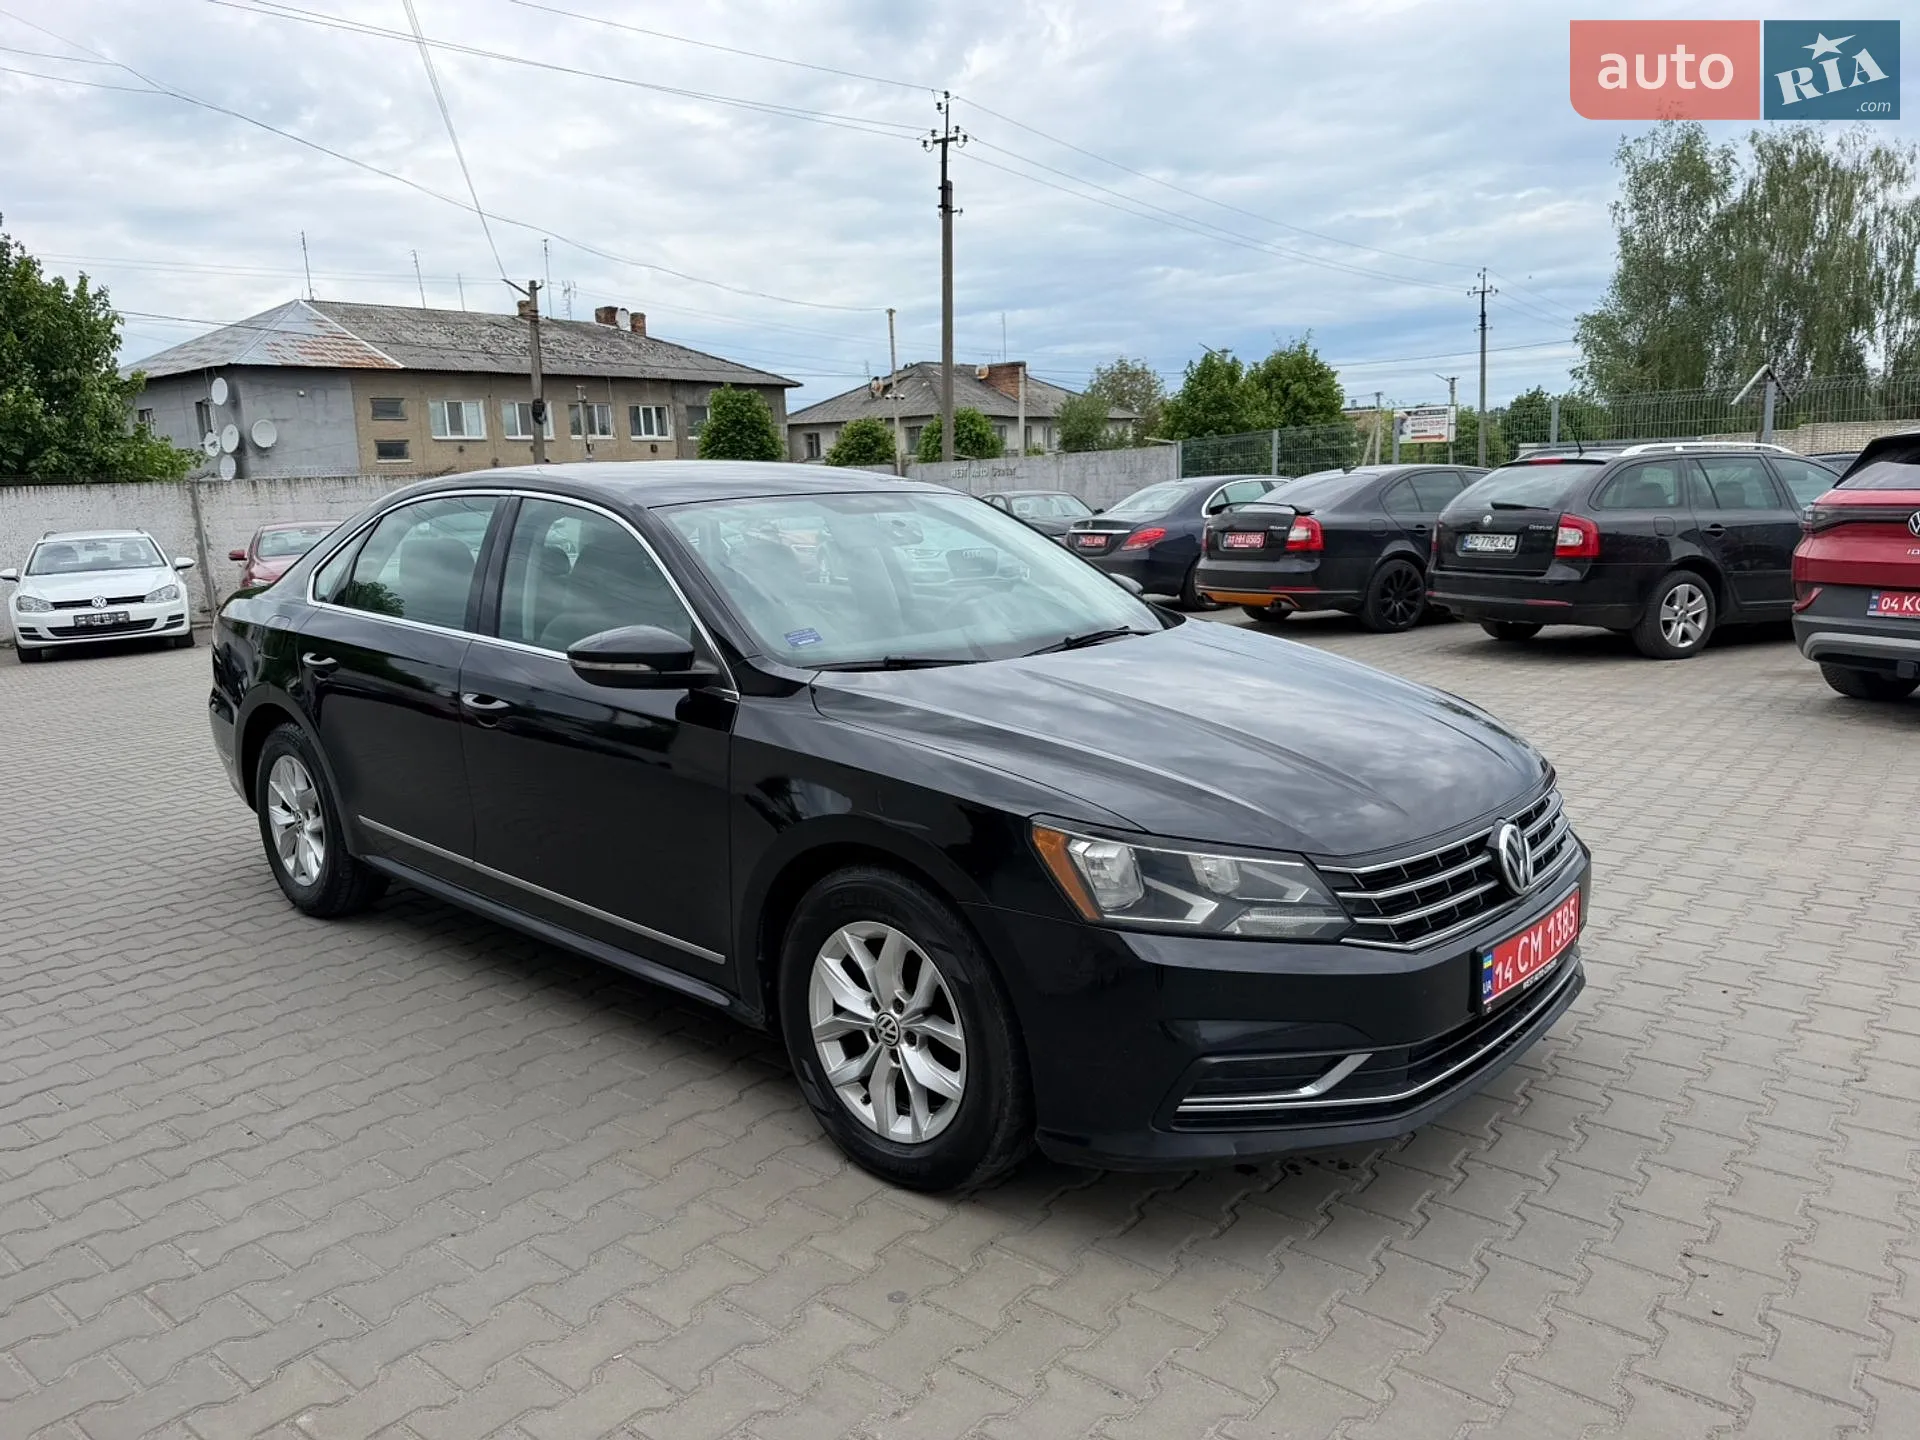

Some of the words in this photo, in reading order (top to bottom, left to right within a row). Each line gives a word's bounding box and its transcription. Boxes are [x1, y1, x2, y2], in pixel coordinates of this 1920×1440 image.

[1881, 597, 1899, 610] 04
[1495, 956, 1513, 990] 14
[1517, 925, 1543, 973] CM
[1547, 898, 1576, 953] 1385
